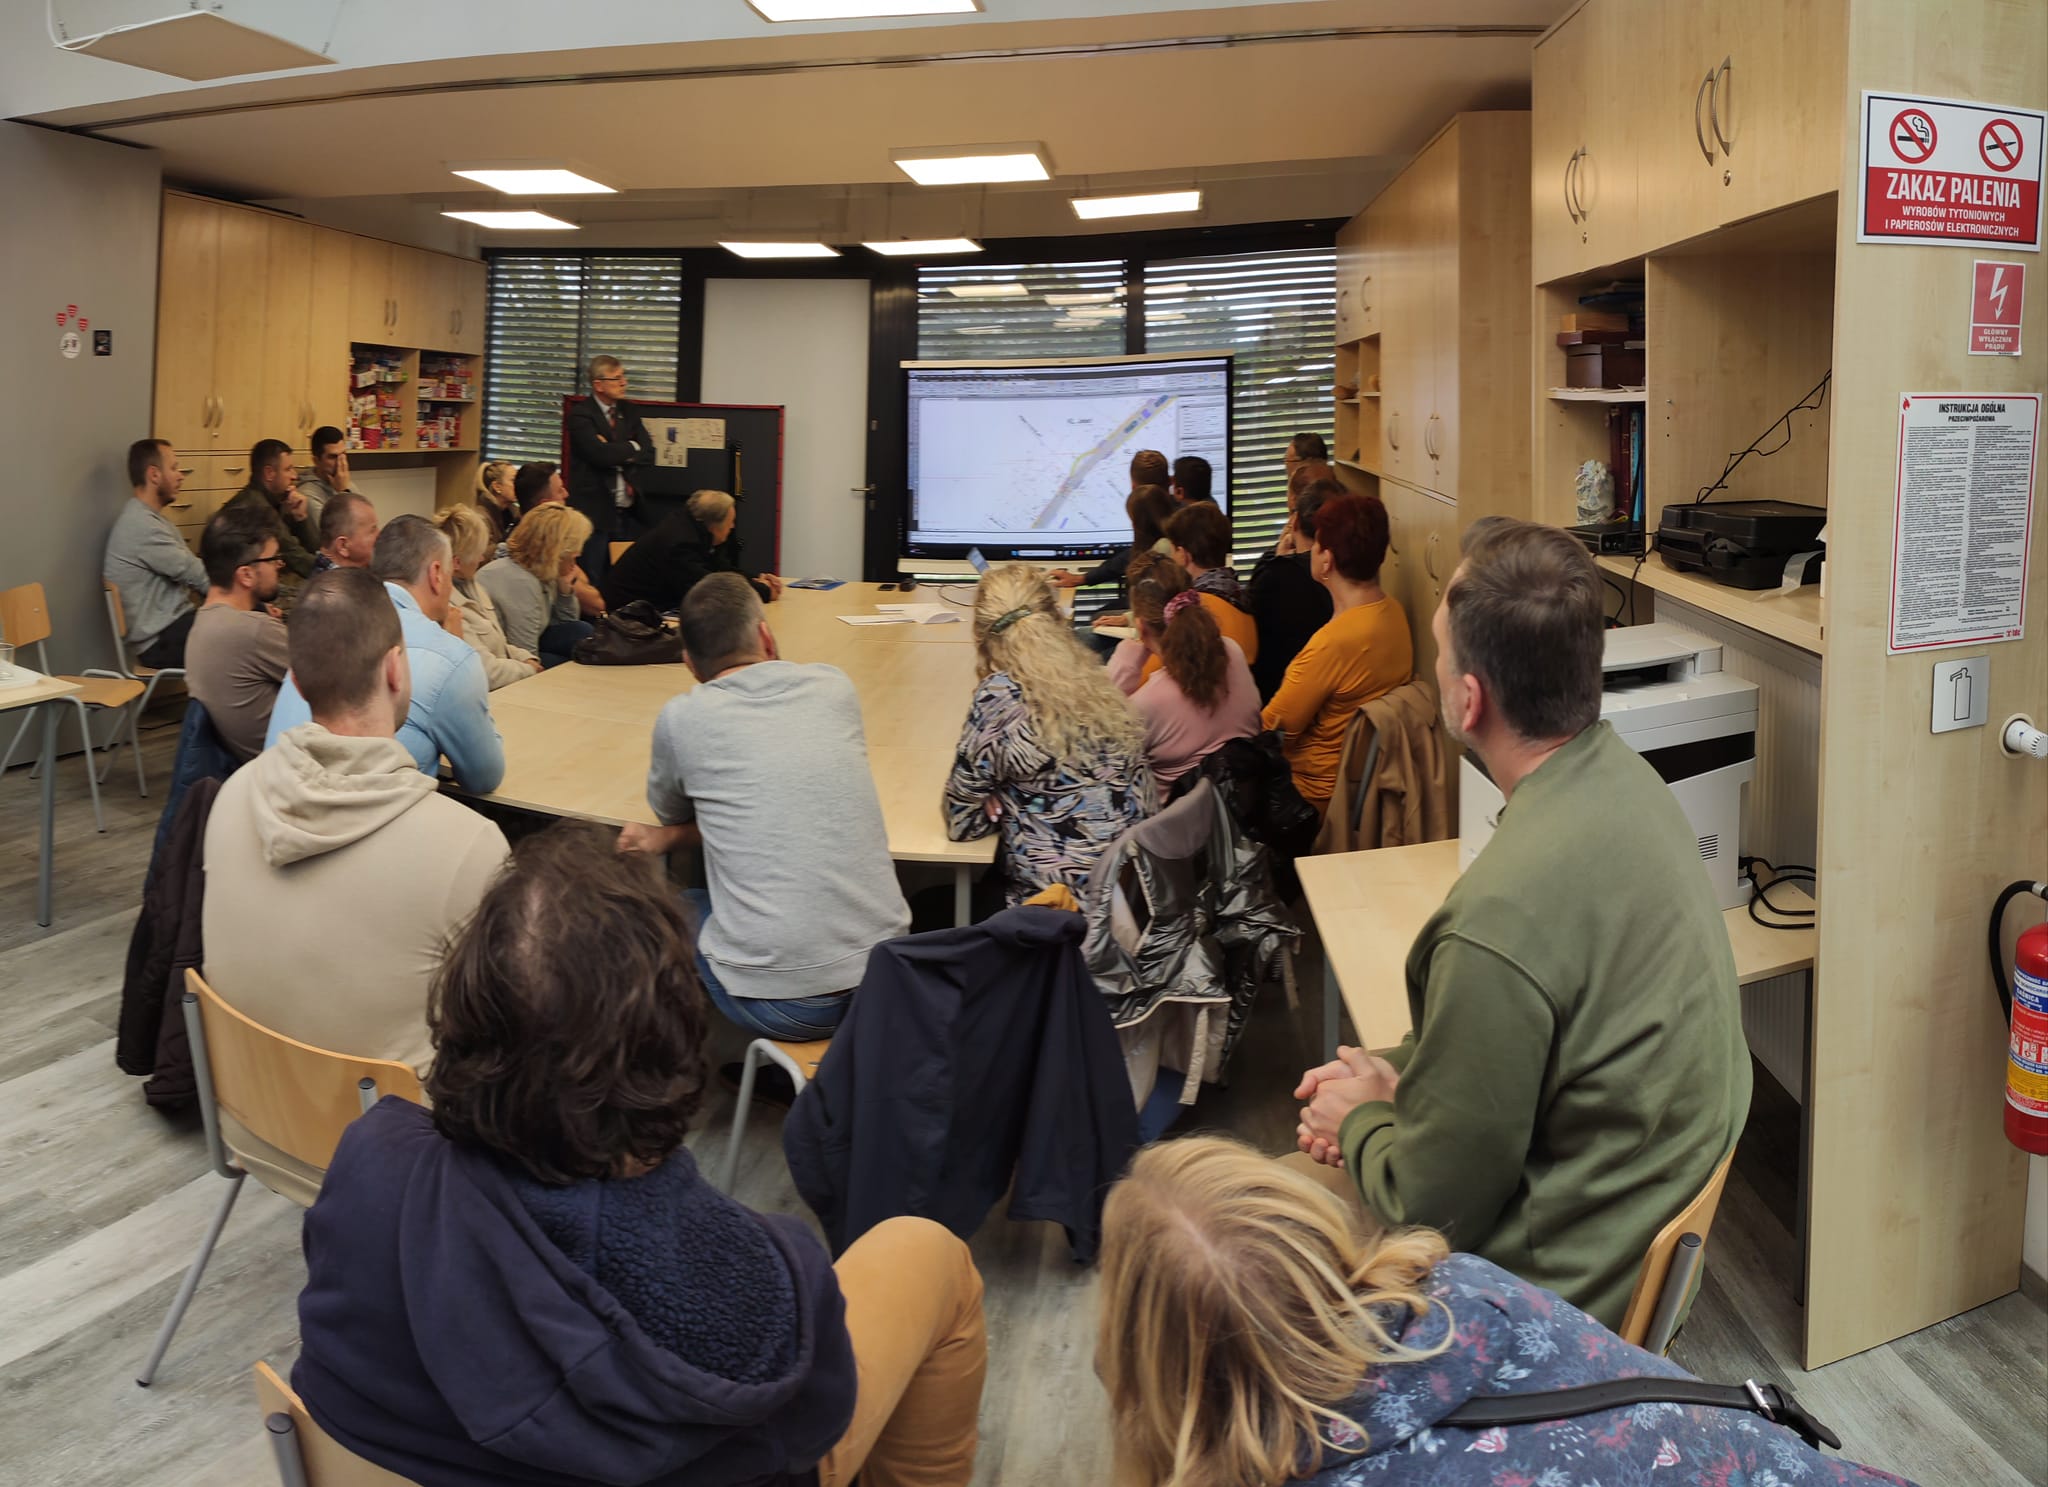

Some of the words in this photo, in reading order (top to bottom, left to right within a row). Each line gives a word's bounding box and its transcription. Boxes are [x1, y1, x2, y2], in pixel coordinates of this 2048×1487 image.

[1886, 172, 1946, 202] ZAKAZ
[1951, 177, 2020, 208] PALENIA
[1902, 205, 1946, 218] WYROBÓW
[1949, 208, 2005, 222] TYTONIOWYCH
[1885, 219, 1889, 229] I
[1890, 219, 1945, 232] PAPIEROSÓW
[1947, 223, 2019, 237] ELEKTRONICZNYCH
[1938, 403, 1979, 413] INSTRUKCJA
[1980, 401, 2006, 413] OGÓLNA
